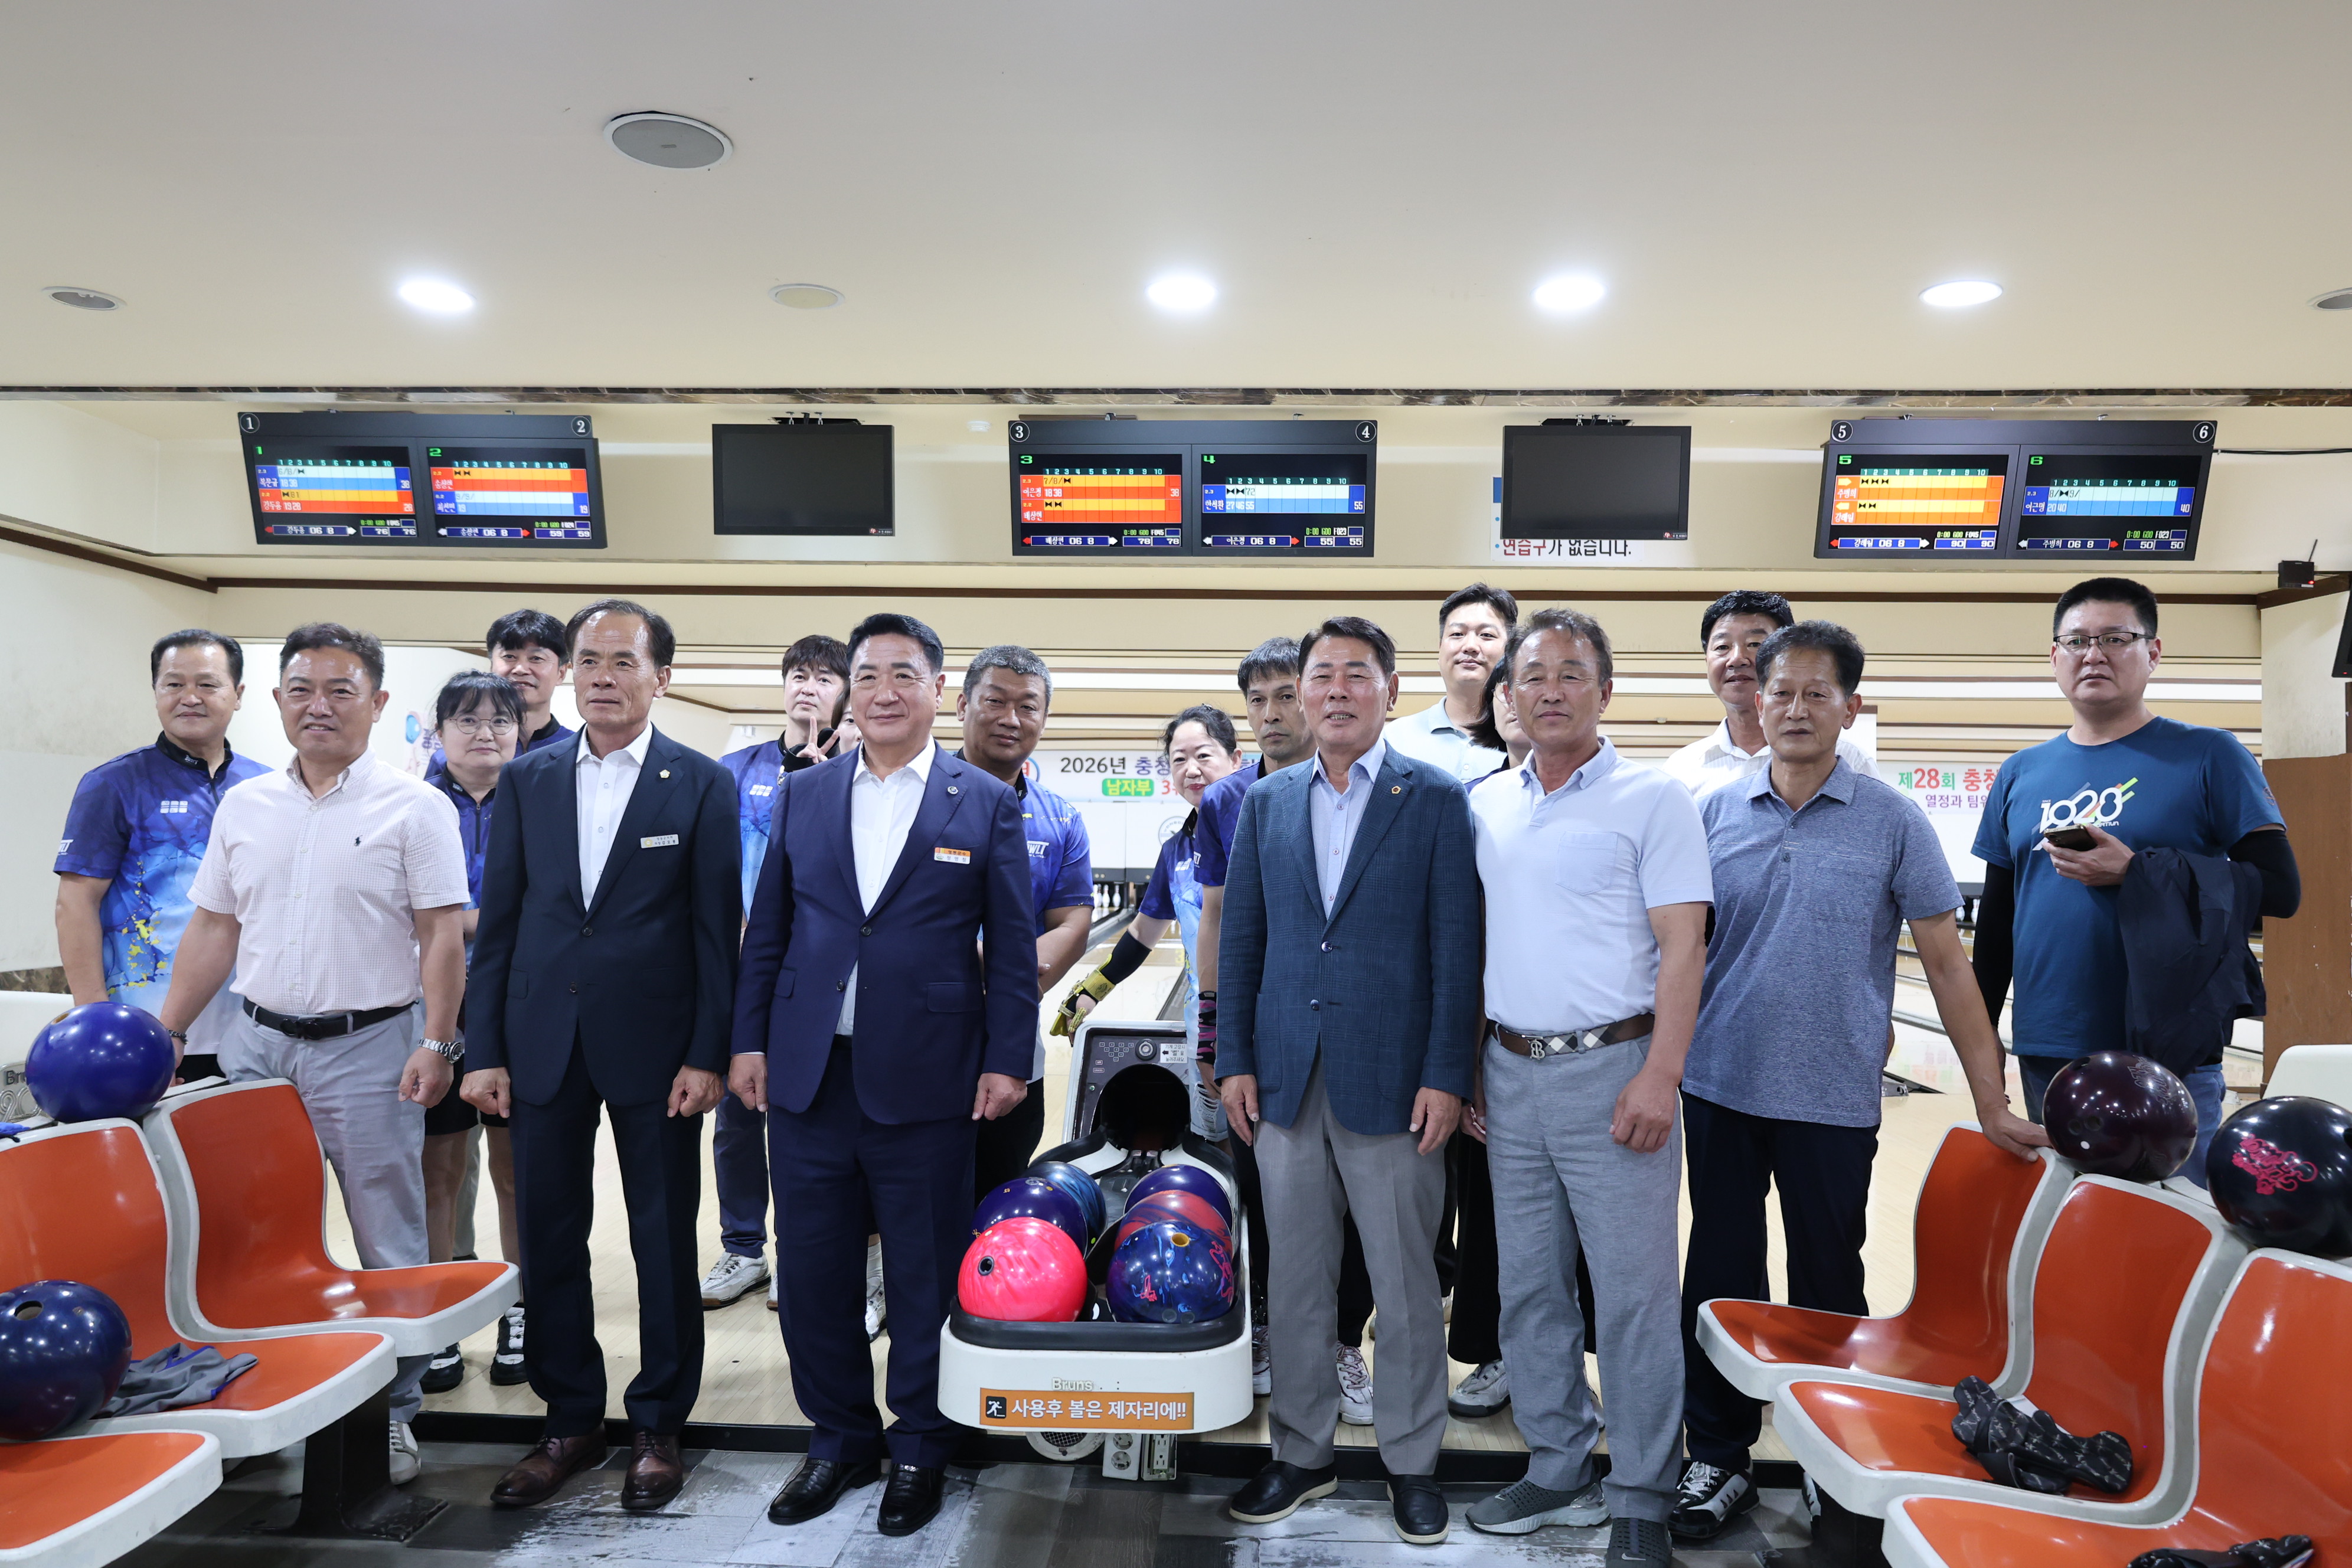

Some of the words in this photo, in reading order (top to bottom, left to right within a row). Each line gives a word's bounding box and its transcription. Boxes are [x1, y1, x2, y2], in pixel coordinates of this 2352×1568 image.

[246, 417, 254, 430] 1
[577, 420, 586, 433] 2
[1015, 426, 1024, 439] 3
[1361, 426, 1370, 438] 4
[1838, 425, 1847, 439] 5
[2199, 426, 2209, 439] 6
[256, 446, 263, 455] 1
[429, 448, 442, 456] 2
[1020, 456, 1033, 464] 3
[1204, 455, 1216, 463] 4
[1839, 455, 1852, 465] 5
[2030, 456, 2043, 465] 6
[1023, 488, 1042, 497] 이은정
[1044, 489, 1053, 497] 18
[1053, 489, 1062, 497] 38
[1170, 489, 1180, 497] 38
[579, 505, 588, 514] 19
[1354, 501, 1363, 509] 55
[2047, 503, 2056, 512] 20
[2057, 503, 2067, 512] 40
[2180, 504, 2190, 512] 40
[1226, 537, 1245, 545] 이은정
[1502, 539, 1562, 556] 연습구가
[1568, 540, 1632, 556] 없습니다.
[1061, 757, 1126, 775] 2026년
[1898, 768, 1955, 790] 제28회
[1107, 779, 1152, 796] 남자부
[1926, 795, 1962, 808] 열정과
[1011, 1399, 1063, 1419] 사용후
[1068, 1400, 1103, 1419] 볼은
[1108, 1399, 1187, 1421] 제자리에!!
